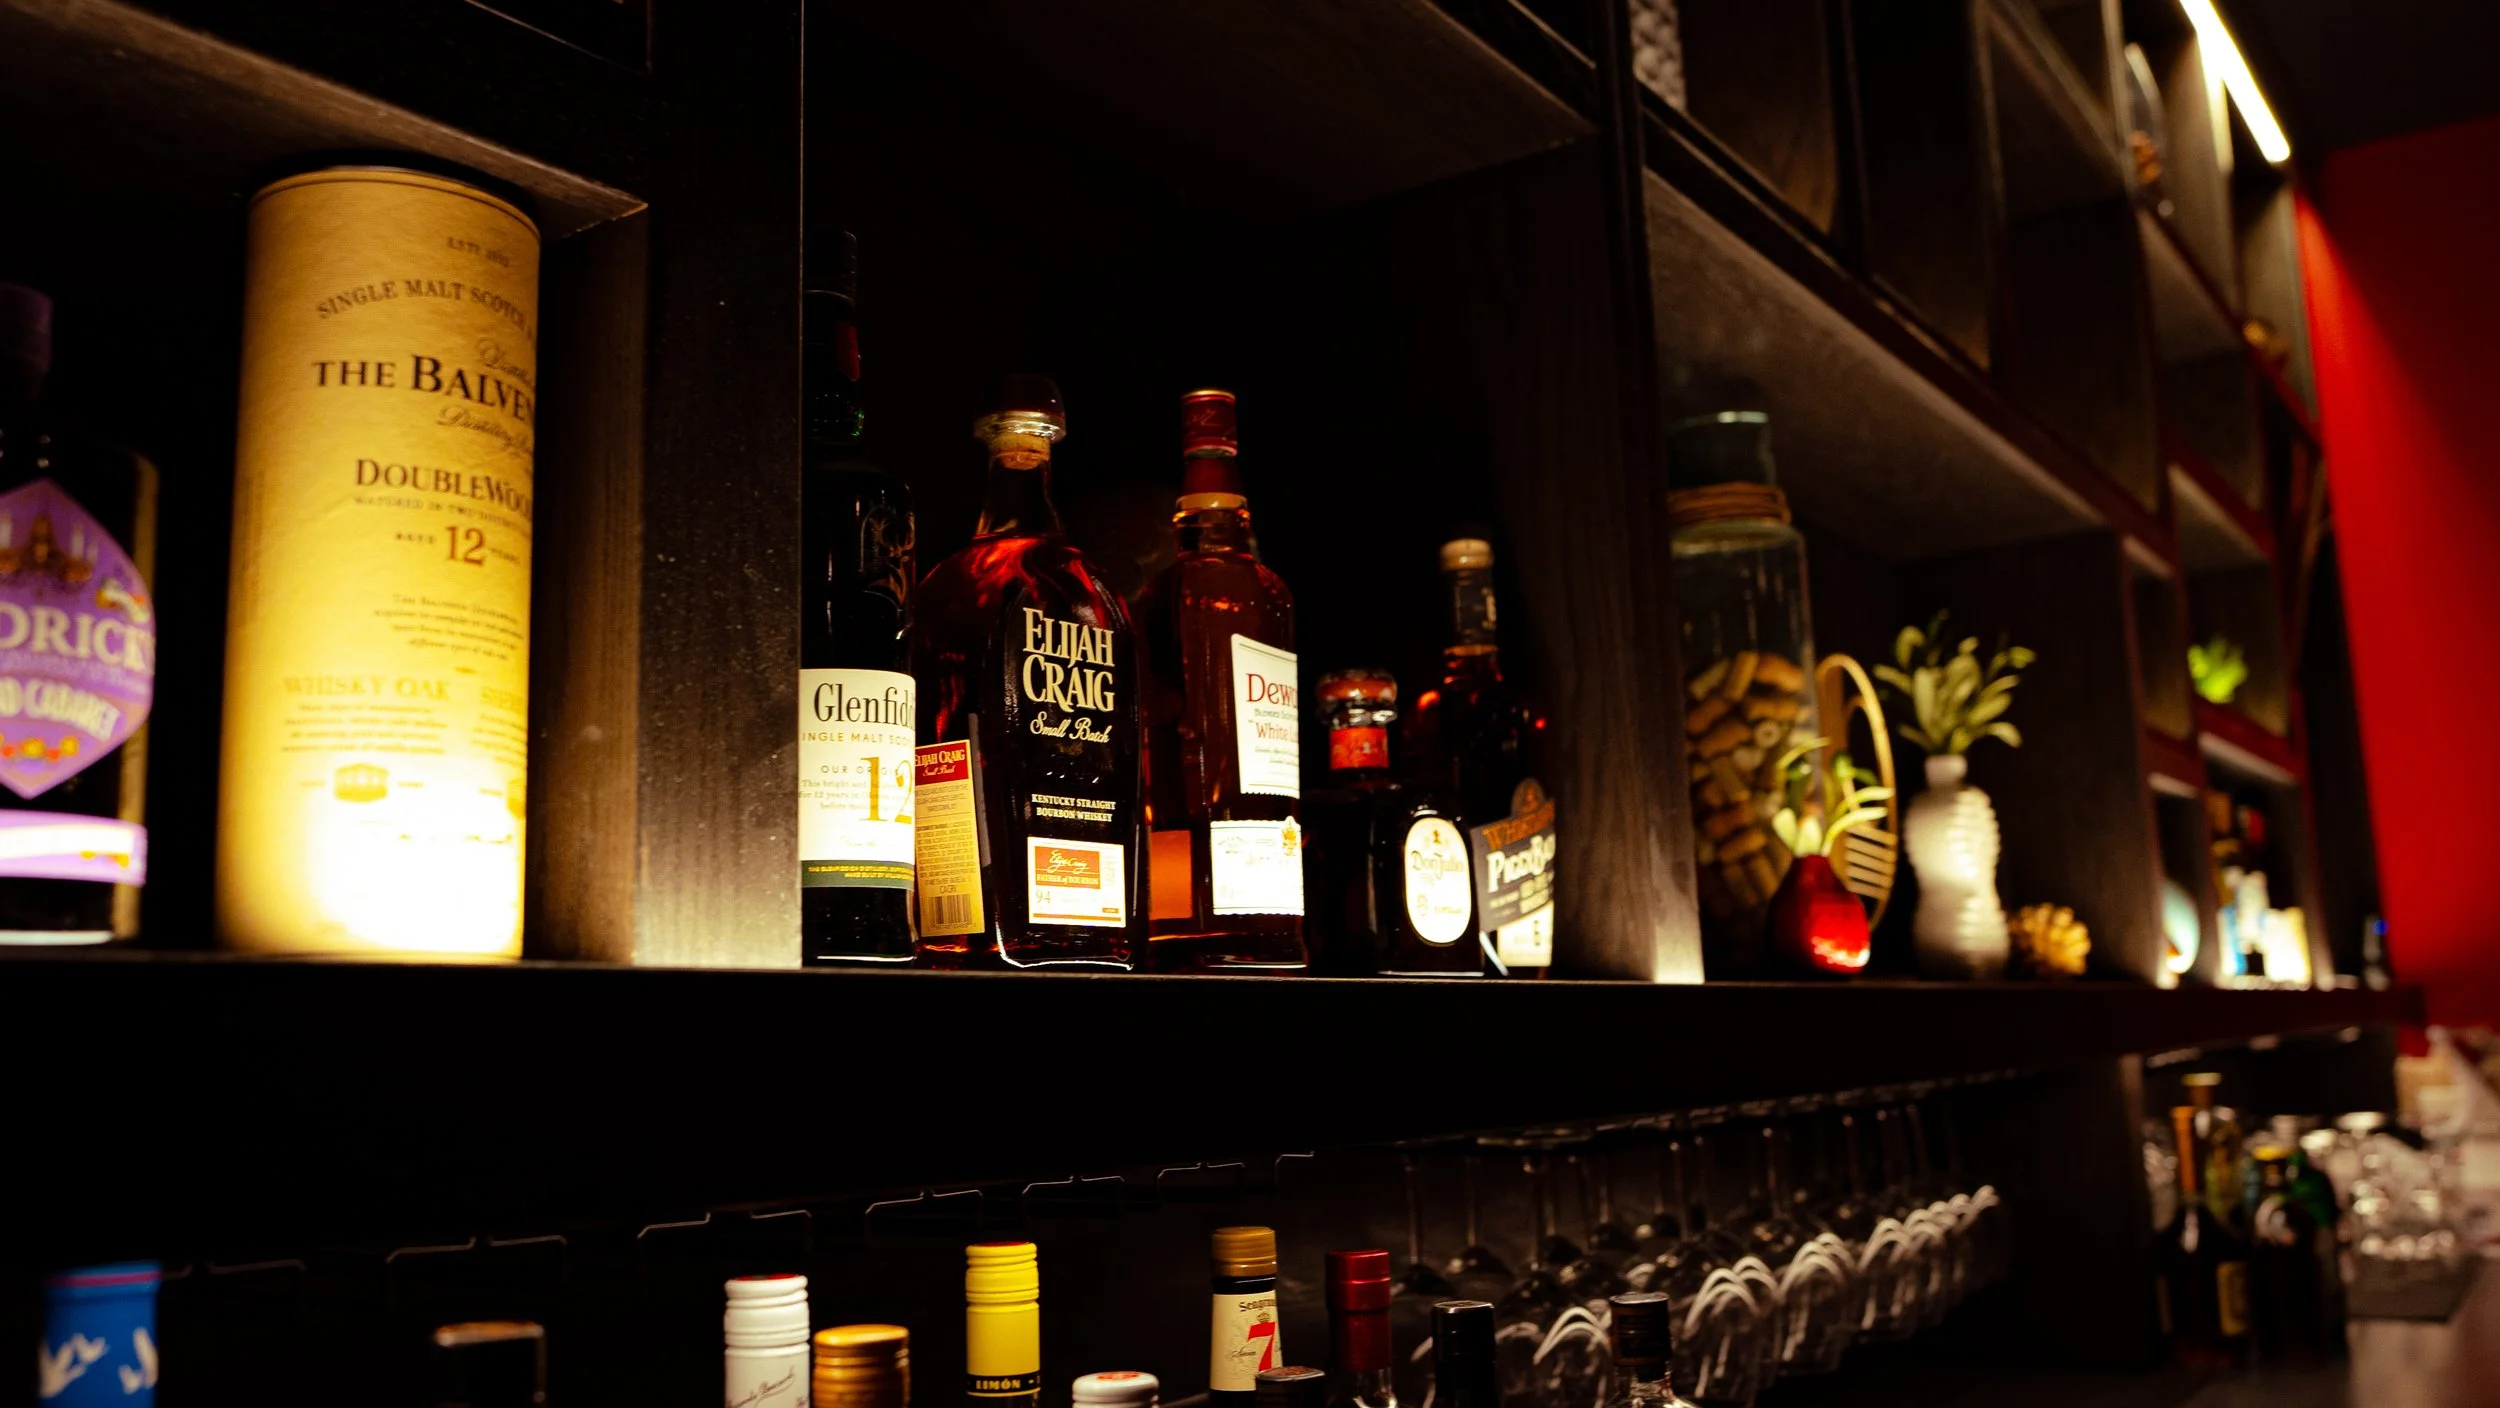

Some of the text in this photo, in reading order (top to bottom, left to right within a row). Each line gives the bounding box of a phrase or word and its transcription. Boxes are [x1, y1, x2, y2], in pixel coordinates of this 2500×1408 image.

[316, 281, 399, 319] SINGLE
[403, 280, 464, 300] MALT
[311, 361, 397, 388] THE
[446, 525, 487, 567] 12
[1023, 607, 1115, 668] ELIJAH
[1023, 653, 1115, 713] CRAIG
[850, 733, 884, 743] MALT
[1030, 710, 1113, 744] Small Batch
[820, 765, 849, 775] OUR
[939, 749, 966, 763] CRAIG
[859, 757, 913, 824] 12
[1031, 794, 1116, 810] KENTUCKY STRAIGHT
[1036, 807, 1113, 822] BOURBON WHISKEY
[1246, 1321, 1276, 1373] 7
[976, 1378, 1021, 1390] LIMÓN
